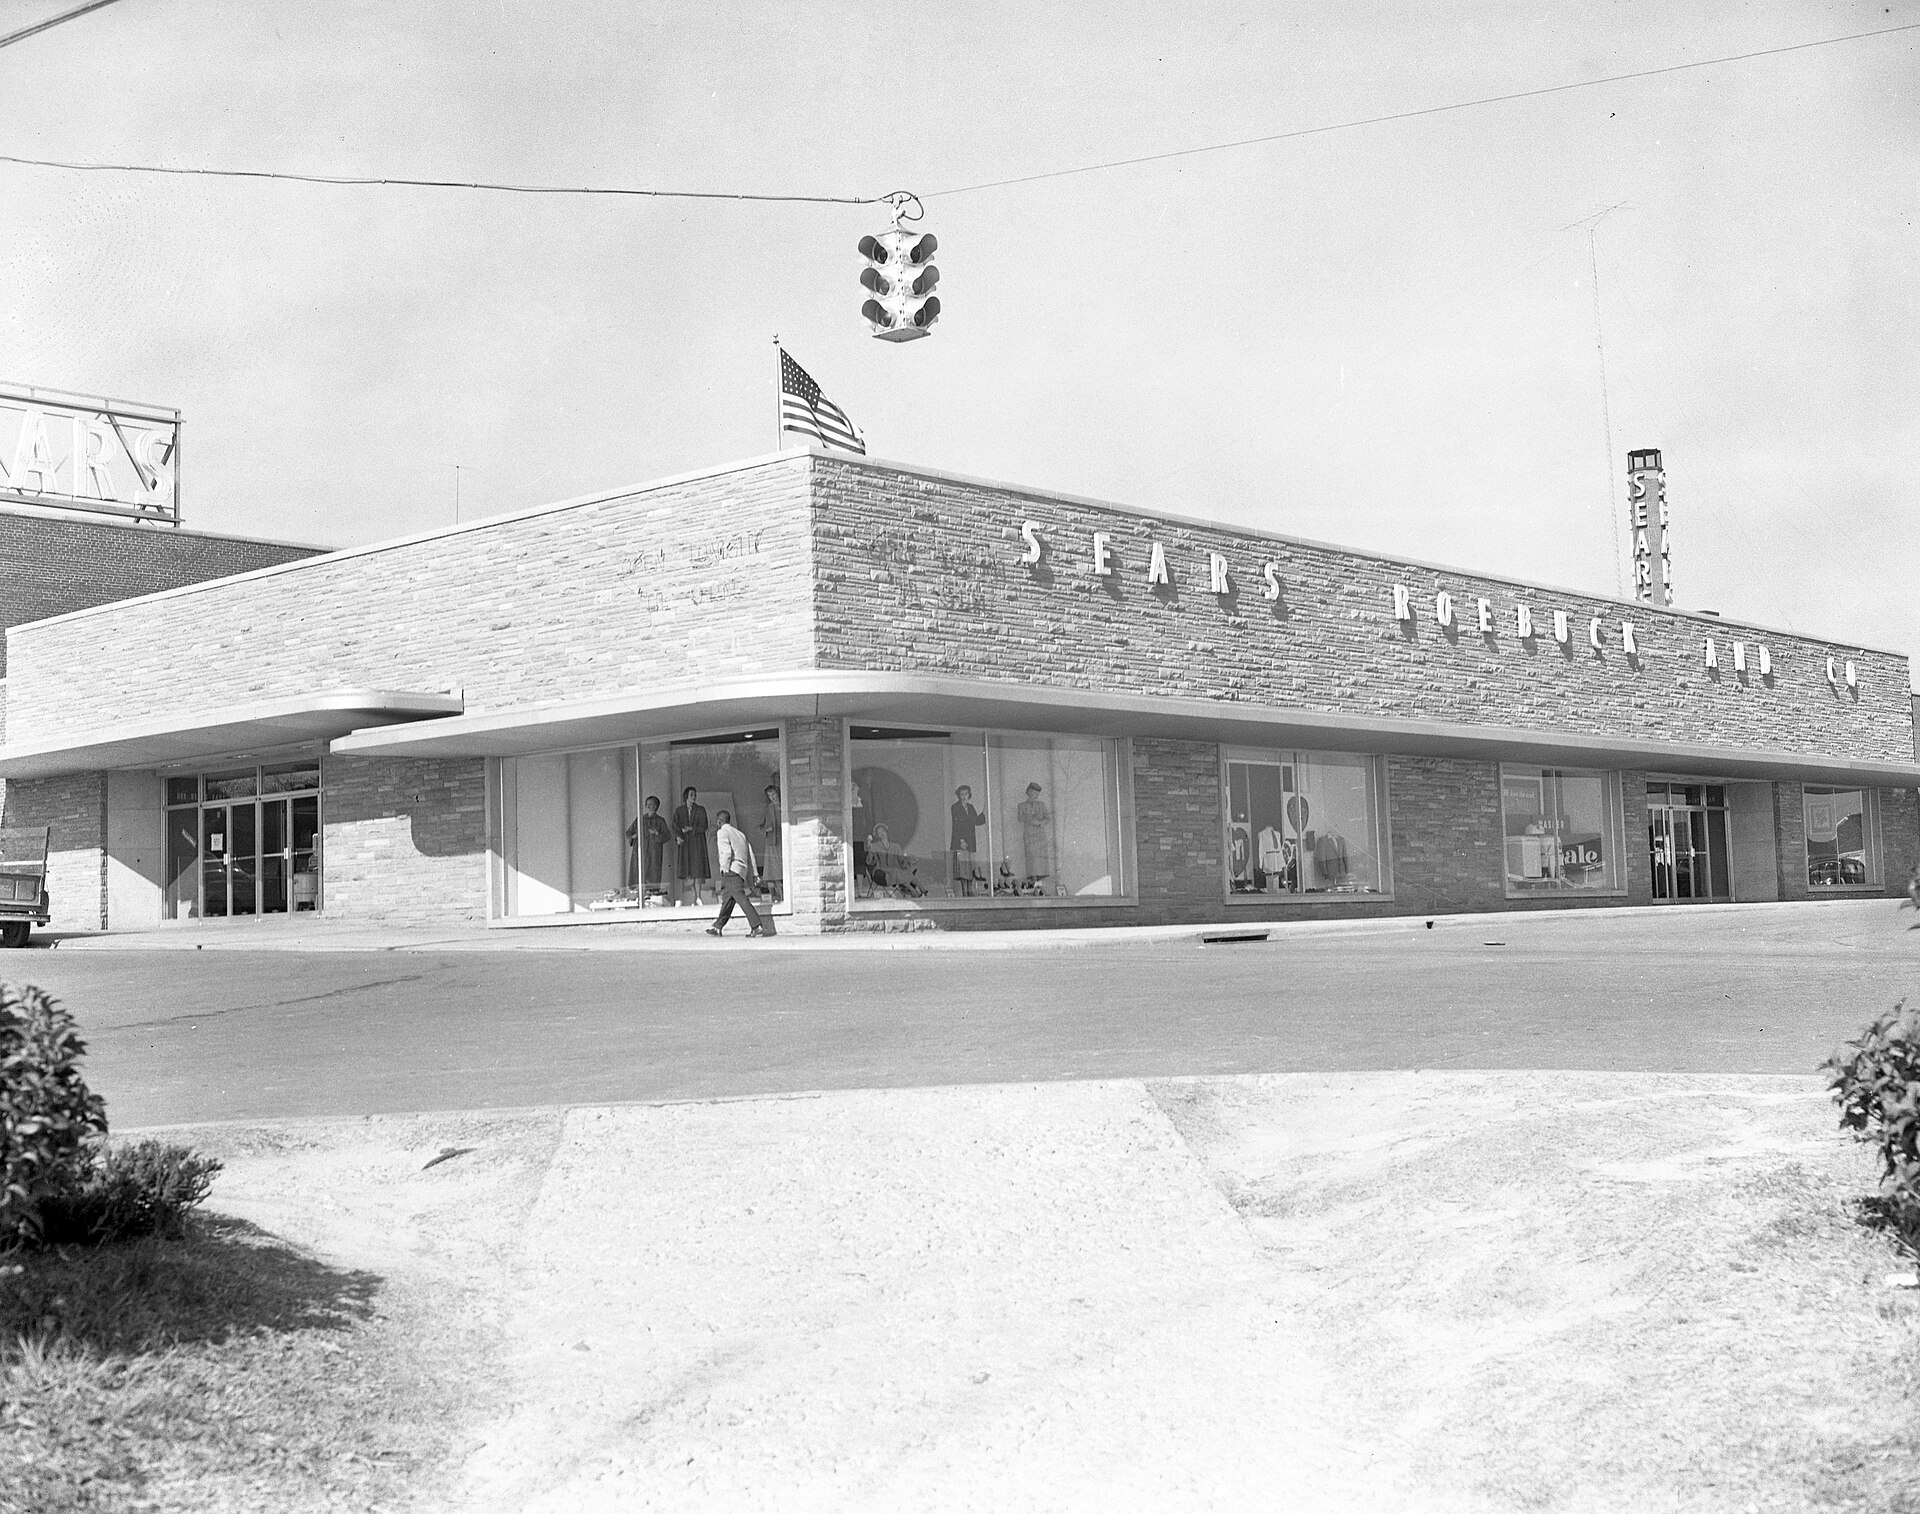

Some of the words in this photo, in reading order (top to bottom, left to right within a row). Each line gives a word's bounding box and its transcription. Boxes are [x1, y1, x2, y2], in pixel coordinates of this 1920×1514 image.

[1022, 520, 1280, 600] SEARS
[1394, 584, 1637, 653] ROEBUCK
[1706, 638, 1770, 675] AND
[1827, 656, 1856, 687] CO
[1633, 473, 1651, 604] SEARS
